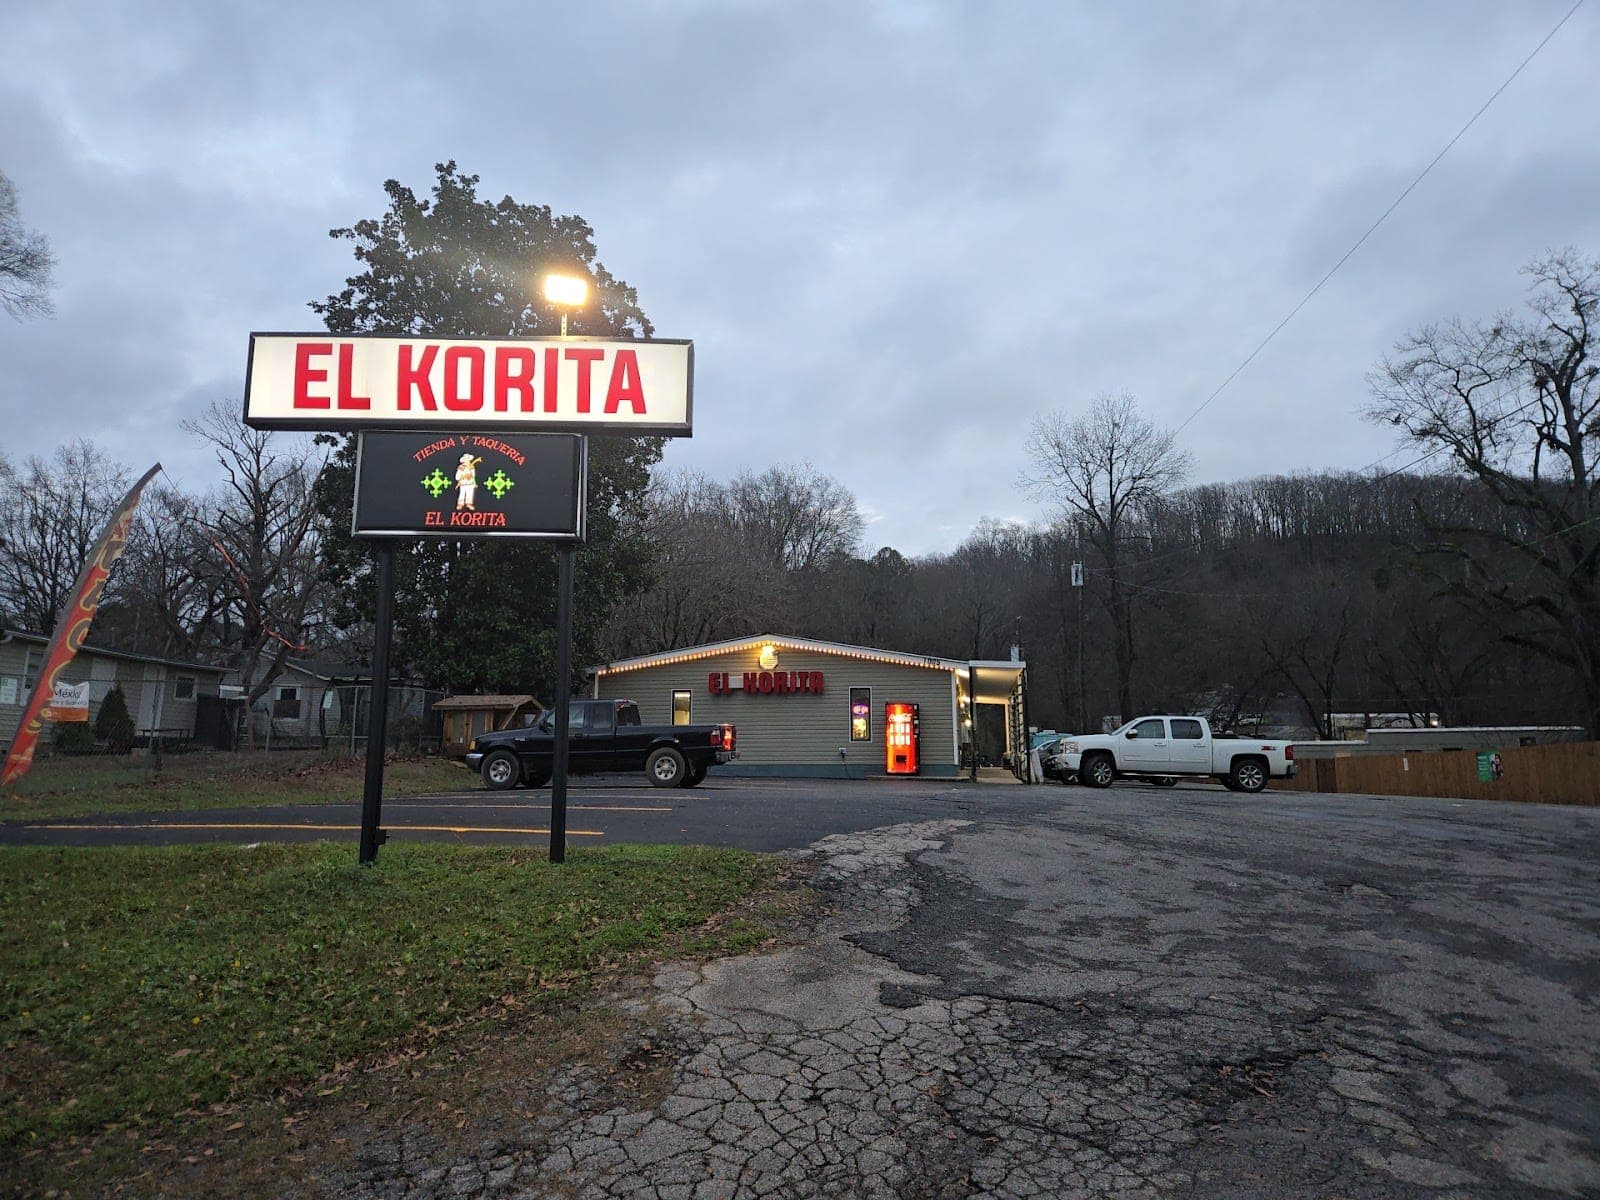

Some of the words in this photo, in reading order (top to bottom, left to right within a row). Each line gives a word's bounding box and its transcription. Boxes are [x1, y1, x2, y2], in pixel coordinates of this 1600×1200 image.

[293, 342, 371, 410] EL
[396, 344, 647, 414] KORITA
[413, 437, 456, 462] TIENDA
[460, 435, 470, 446] Y
[472, 436, 526, 466] TAQUERIA
[425, 511, 445, 526] EL
[450, 511, 506, 527] KORITA
[708, 671, 731, 695] EL
[742, 671, 825, 695] KORITA
